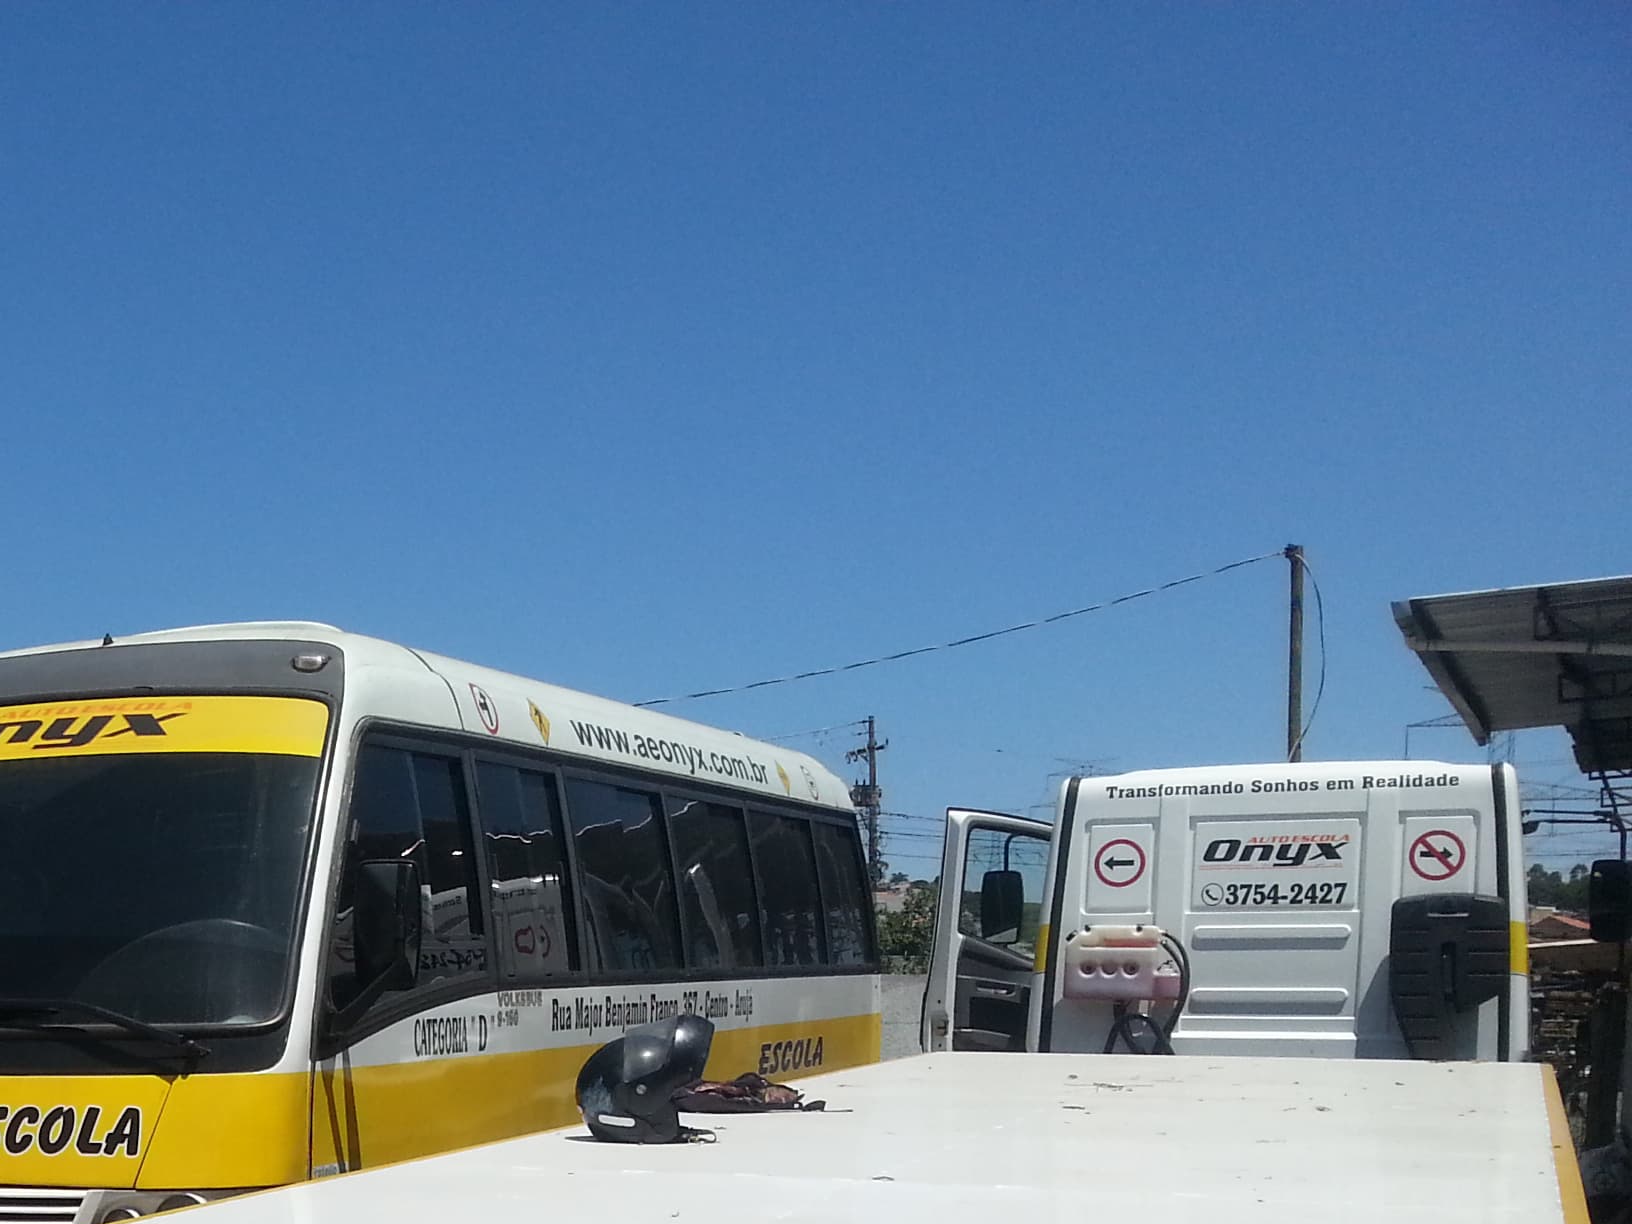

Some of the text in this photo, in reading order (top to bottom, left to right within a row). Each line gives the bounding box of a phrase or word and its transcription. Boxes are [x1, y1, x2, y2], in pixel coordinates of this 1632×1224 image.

[569, 720, 768, 784] www.aeonyx.com.br
[1107, 773, 1460, 799] Transformando Sonhos em Realidade
[1203, 839, 1352, 867] Onyx
[1248, 833, 1350, 844] AUTO ESCOLA
[1226, 882, 1348, 906] 3754-2427
[552, 998, 572, 1032] Rua
[575, 997, 602, 1037] Major
[605, 993, 647, 1034] Benjamin
[414, 1016, 468, 1057] CATEGORIA
[759, 1036, 823, 1075] ESCOLA
